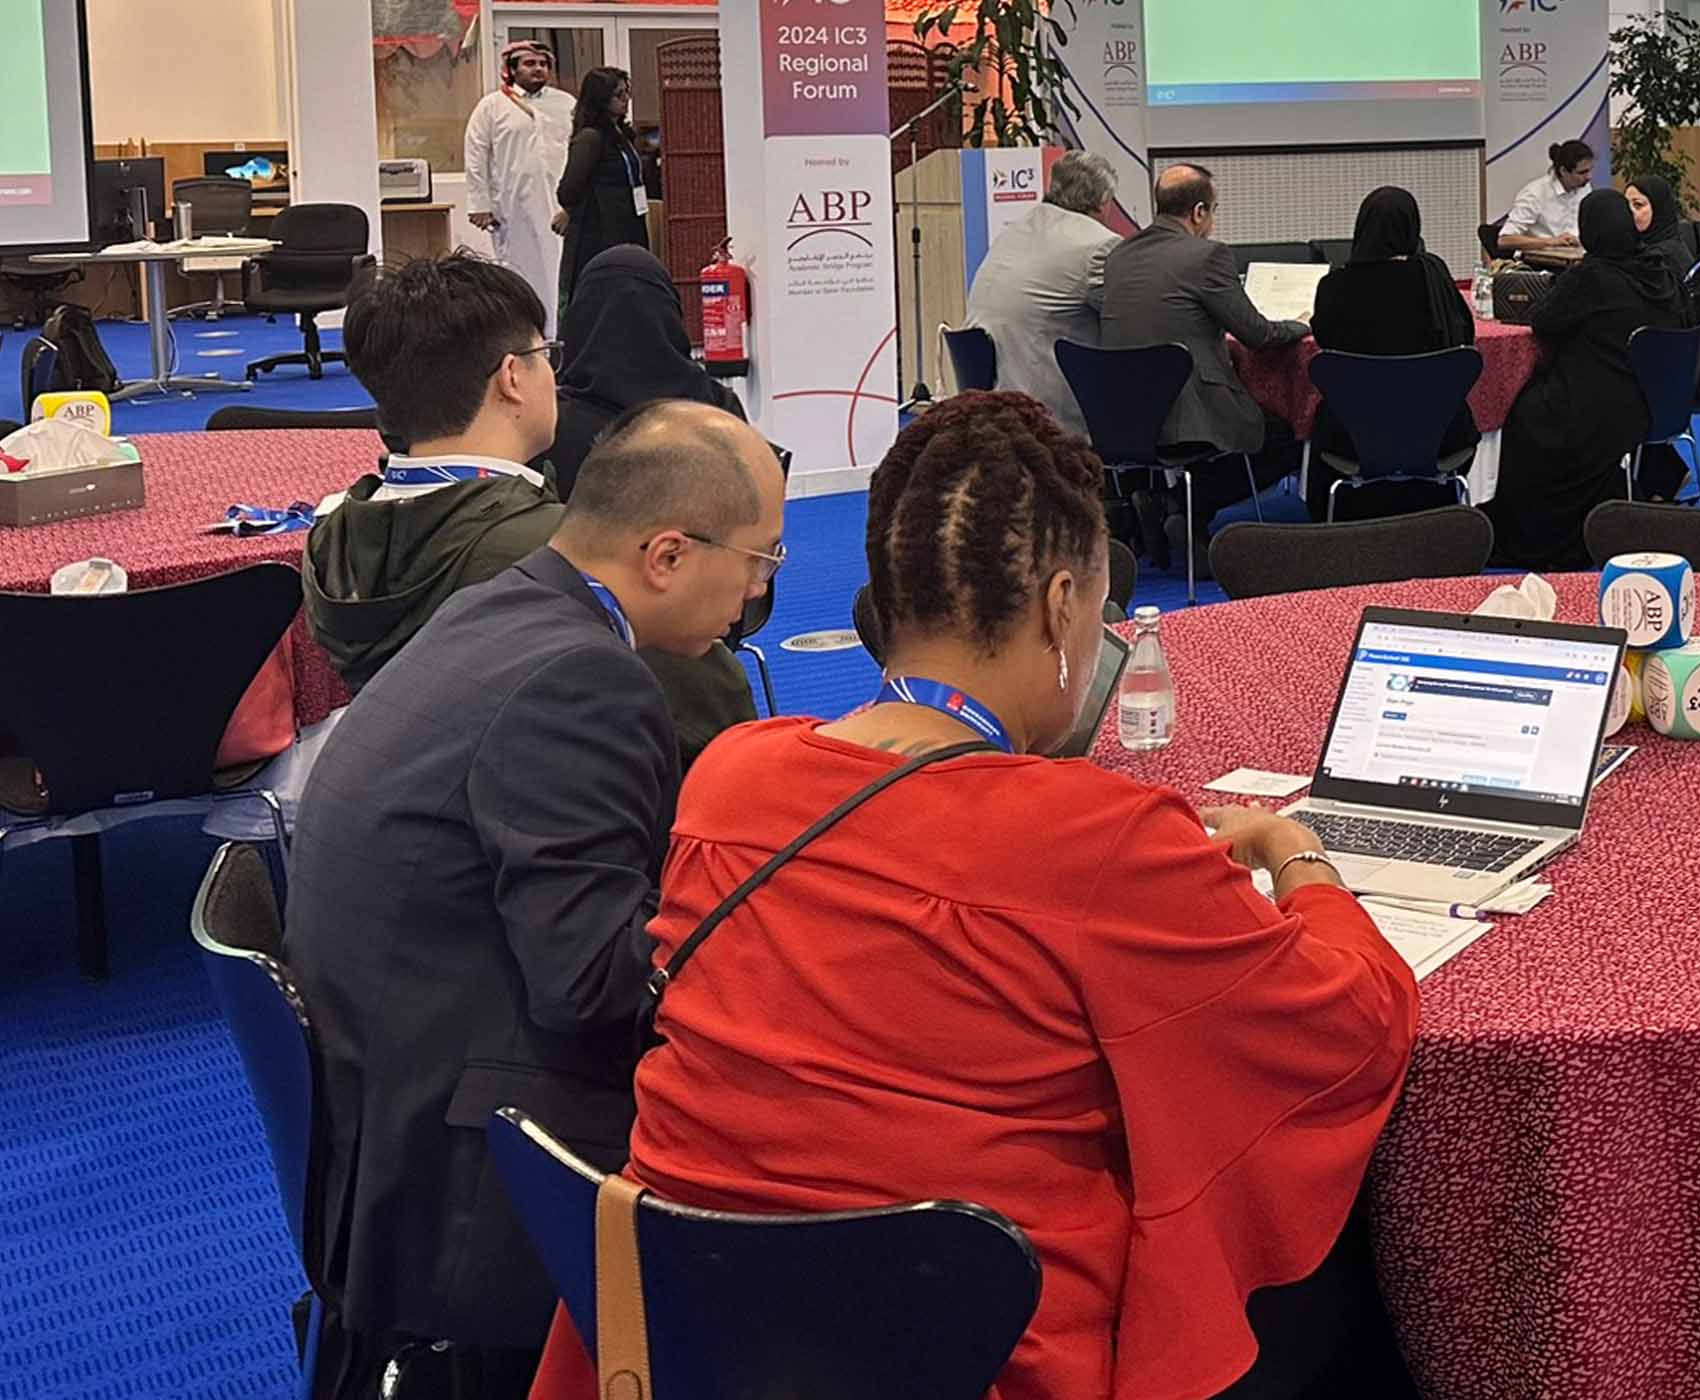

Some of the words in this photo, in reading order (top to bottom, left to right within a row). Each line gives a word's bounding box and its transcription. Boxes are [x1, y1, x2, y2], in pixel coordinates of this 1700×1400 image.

[778, 26, 828, 45] 2024
[835, 27, 867, 45] IC3
[1103, 41, 1136, 60] ABP
[1500, 43, 1546, 60] ABP
[779, 53, 868, 76] Regional
[793, 81, 857, 99] Forum
[788, 190, 871, 222] ABP
[64, 404, 95, 418] ABP
[1646, 590, 1663, 632] ABP
